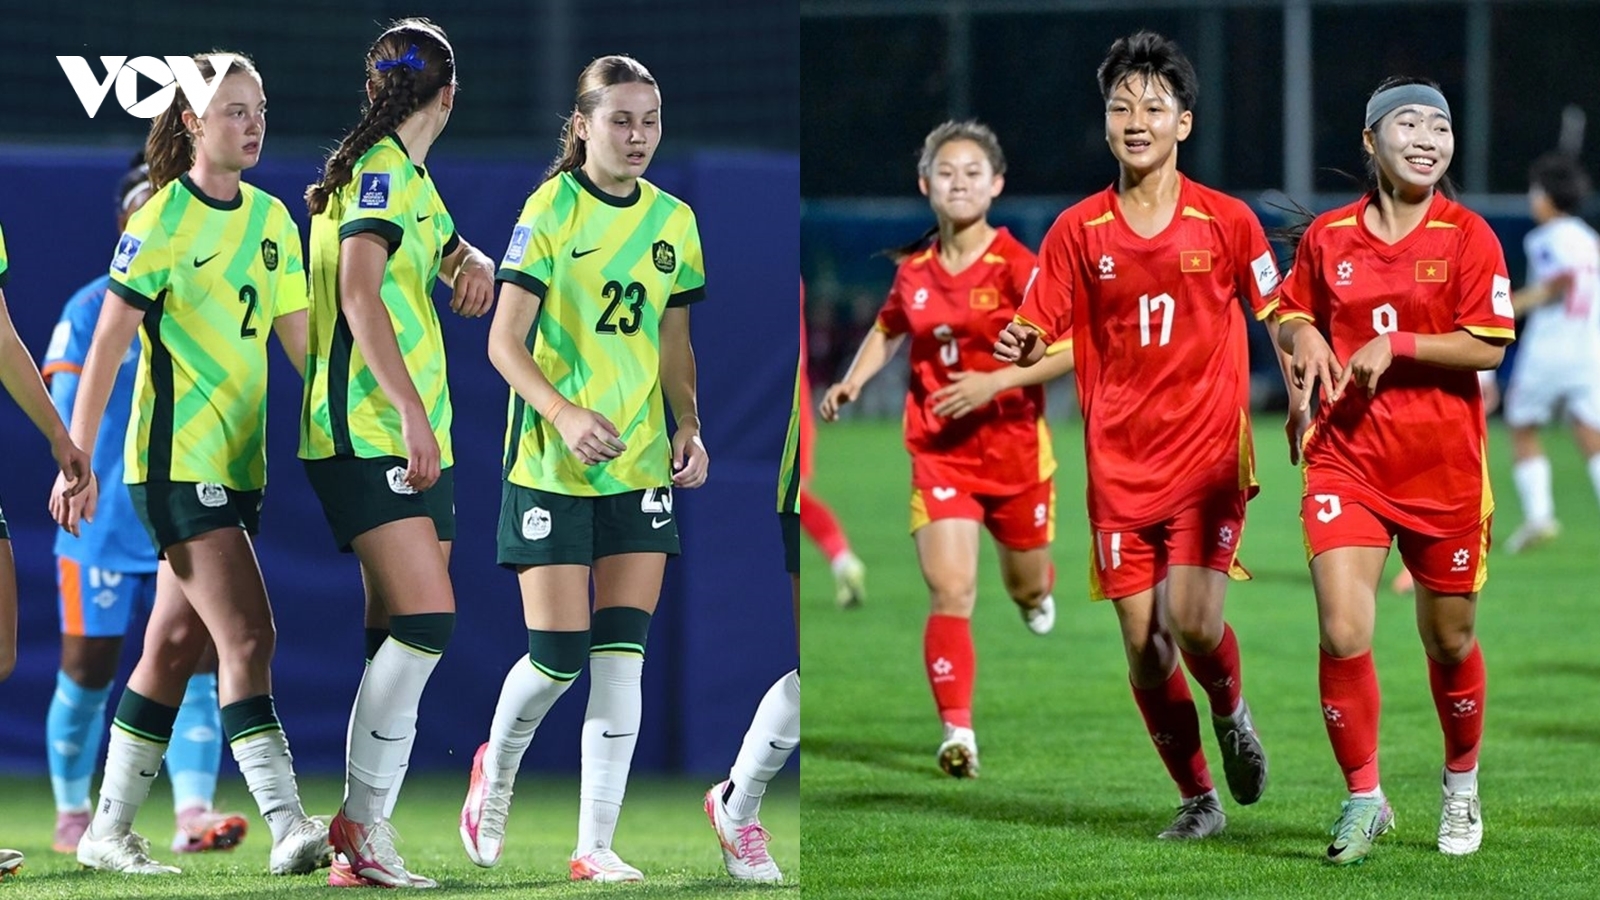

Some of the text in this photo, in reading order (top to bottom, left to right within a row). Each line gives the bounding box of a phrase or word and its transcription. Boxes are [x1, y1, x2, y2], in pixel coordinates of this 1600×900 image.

[239, 284, 259, 340] 2
[595, 280, 647, 336] 23
[1139, 292, 1175, 347] 17
